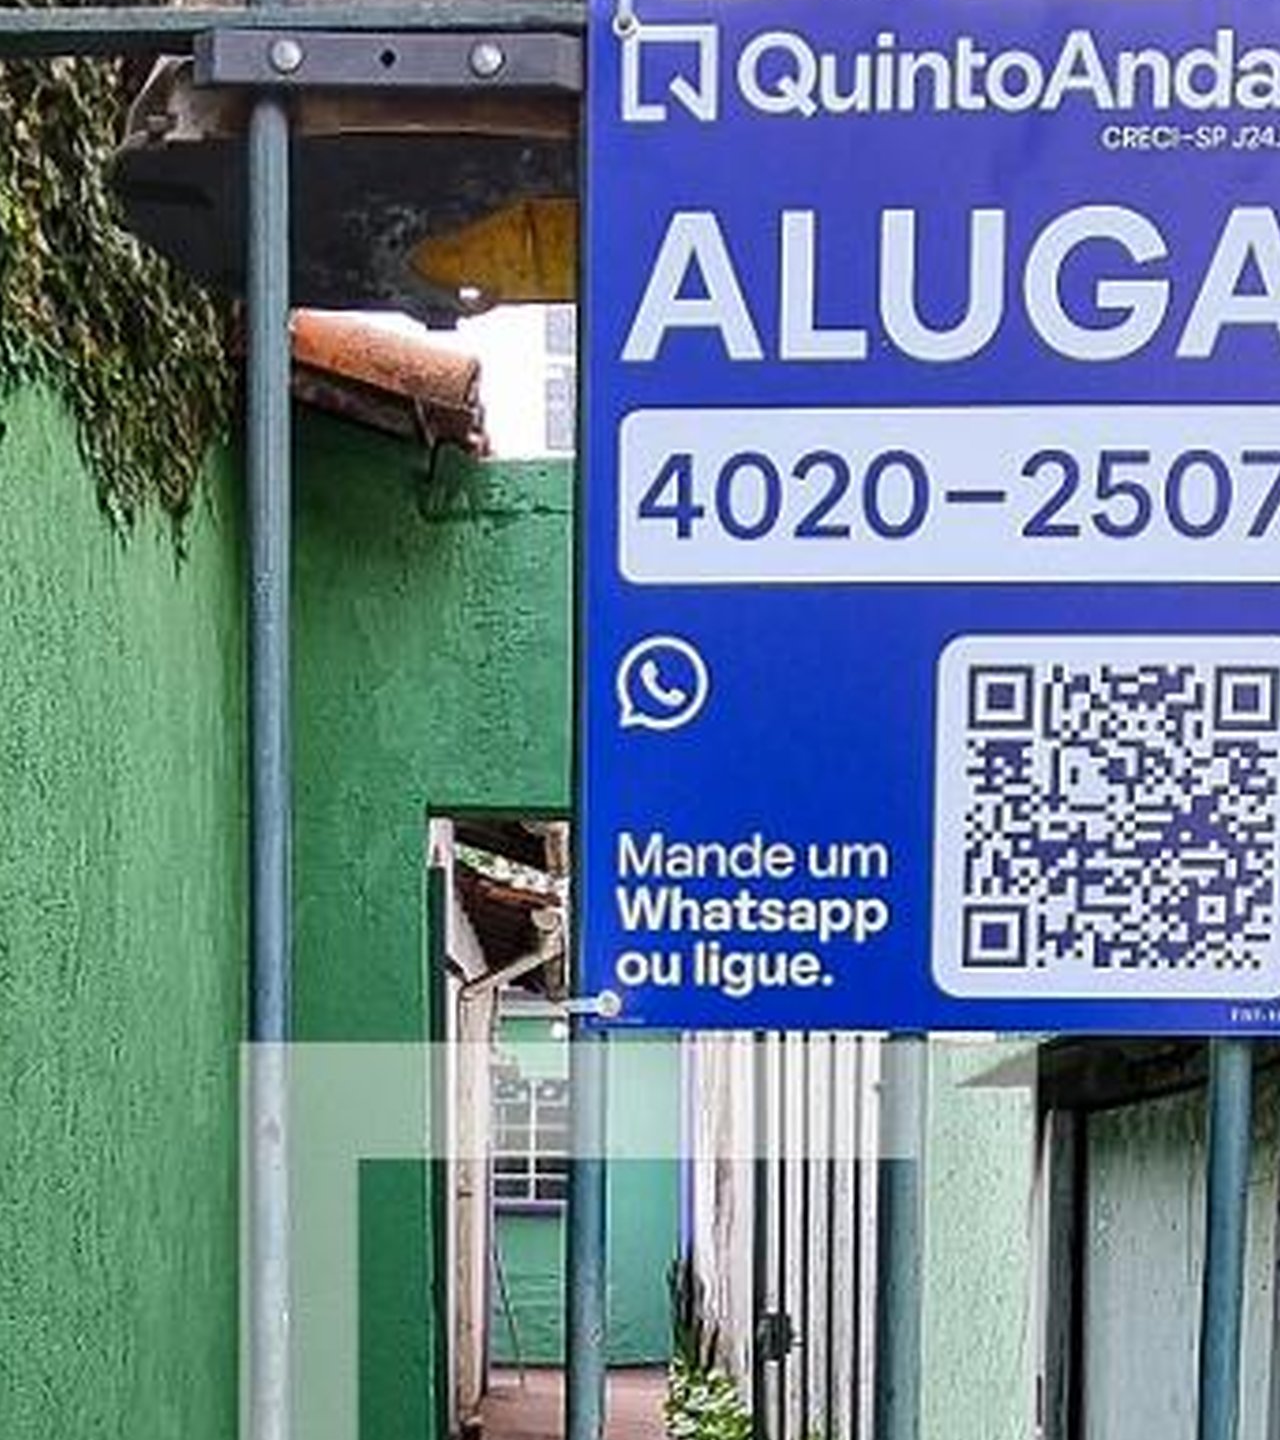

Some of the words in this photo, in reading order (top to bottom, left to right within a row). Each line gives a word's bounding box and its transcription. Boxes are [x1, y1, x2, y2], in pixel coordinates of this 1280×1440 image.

[618, 831, 796, 879] Mande
[807, 842, 889, 879] um
[616, 886, 889, 944] Whatsapp
[616, 950, 682, 986] ou
[694, 940, 834, 998] ligue.
